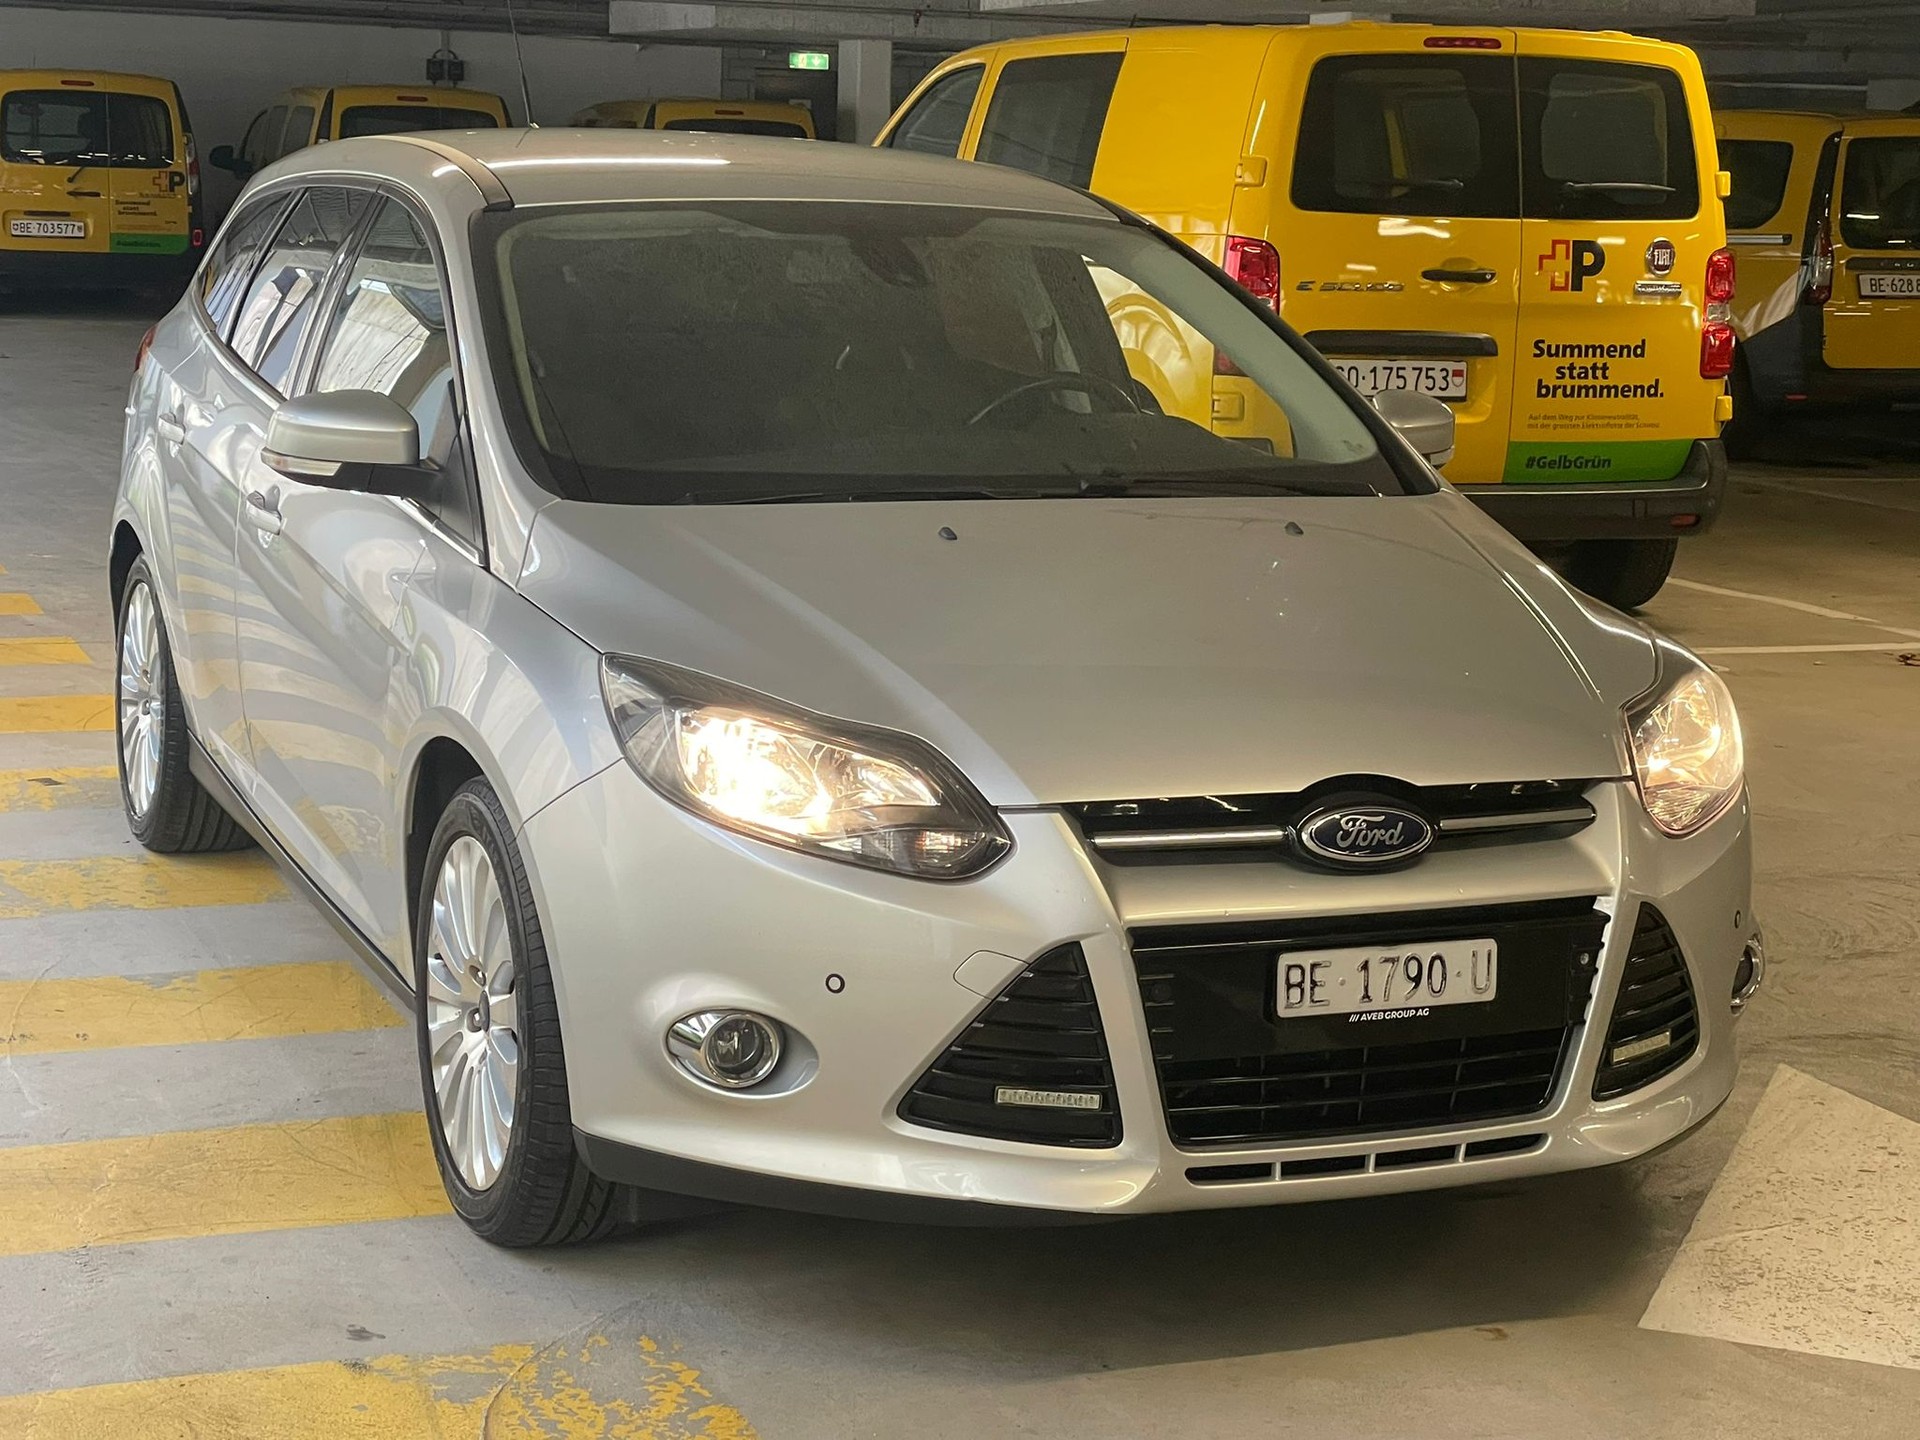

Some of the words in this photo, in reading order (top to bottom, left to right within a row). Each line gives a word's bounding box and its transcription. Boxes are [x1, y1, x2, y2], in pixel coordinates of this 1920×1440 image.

[169, 171, 186, 192] P
[1570, 240, 1606, 292] P
[1654, 249, 1671, 266] FIAT
[1533, 339, 1646, 358] Summend
[1555, 362, 1609, 380] statt
[1536, 378, 1664, 398] brummend.
[1525, 455, 1612, 470] #GelbGrün
[1336, 815, 1405, 848] Ford
[1384, 1009, 1416, 1019] GROUP
[1416, 1008, 1430, 1017] AG
